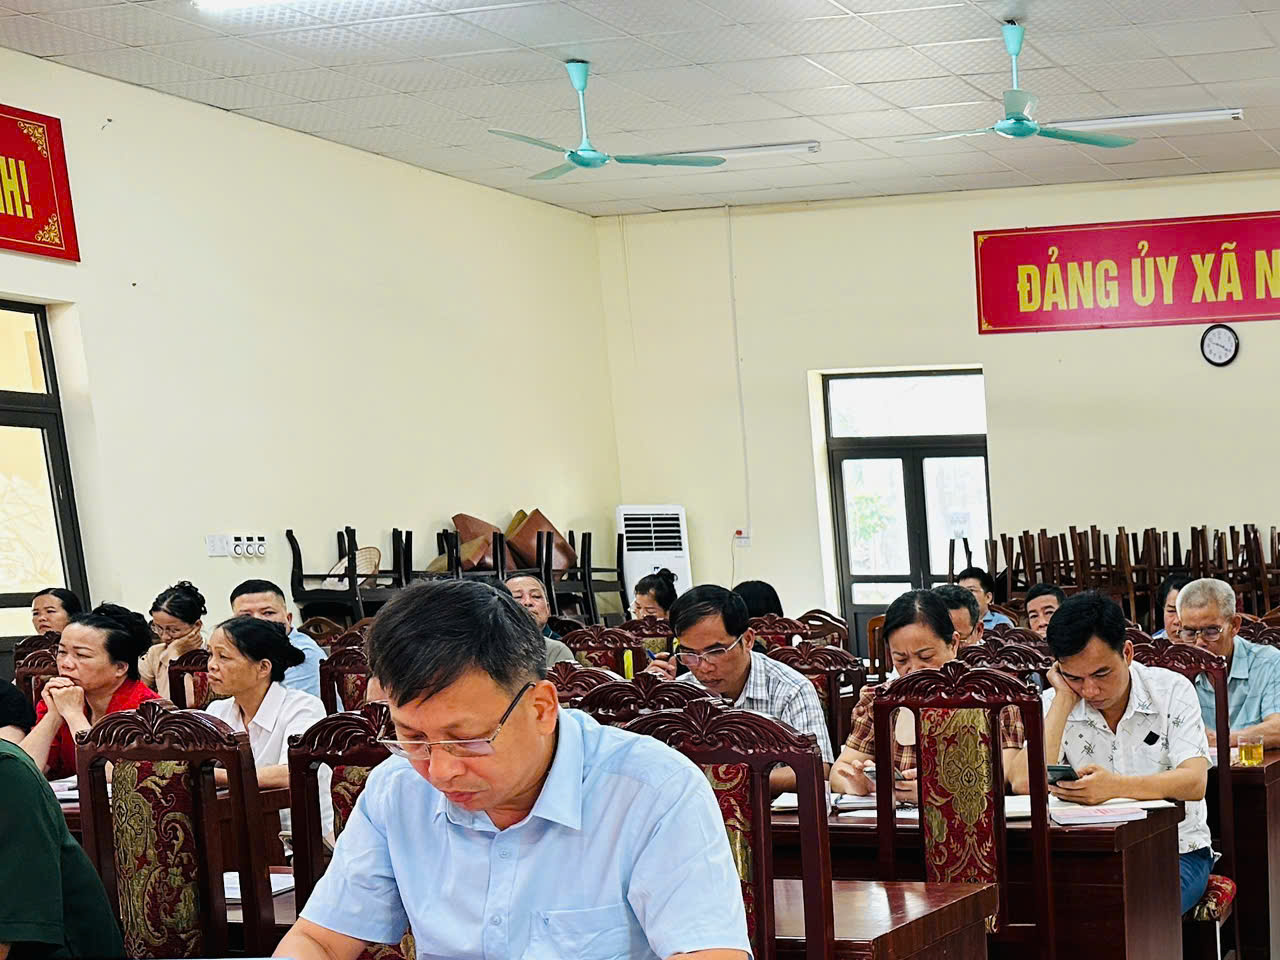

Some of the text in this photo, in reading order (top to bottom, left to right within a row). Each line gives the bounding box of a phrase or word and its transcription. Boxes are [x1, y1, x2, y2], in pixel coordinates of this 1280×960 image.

[0, 155, 34, 219] H!
[1017, 246, 1119, 312] ĐẢNG
[1132, 240, 1179, 307] ỦY
[1191, 242, 1244, 303] XÃ
